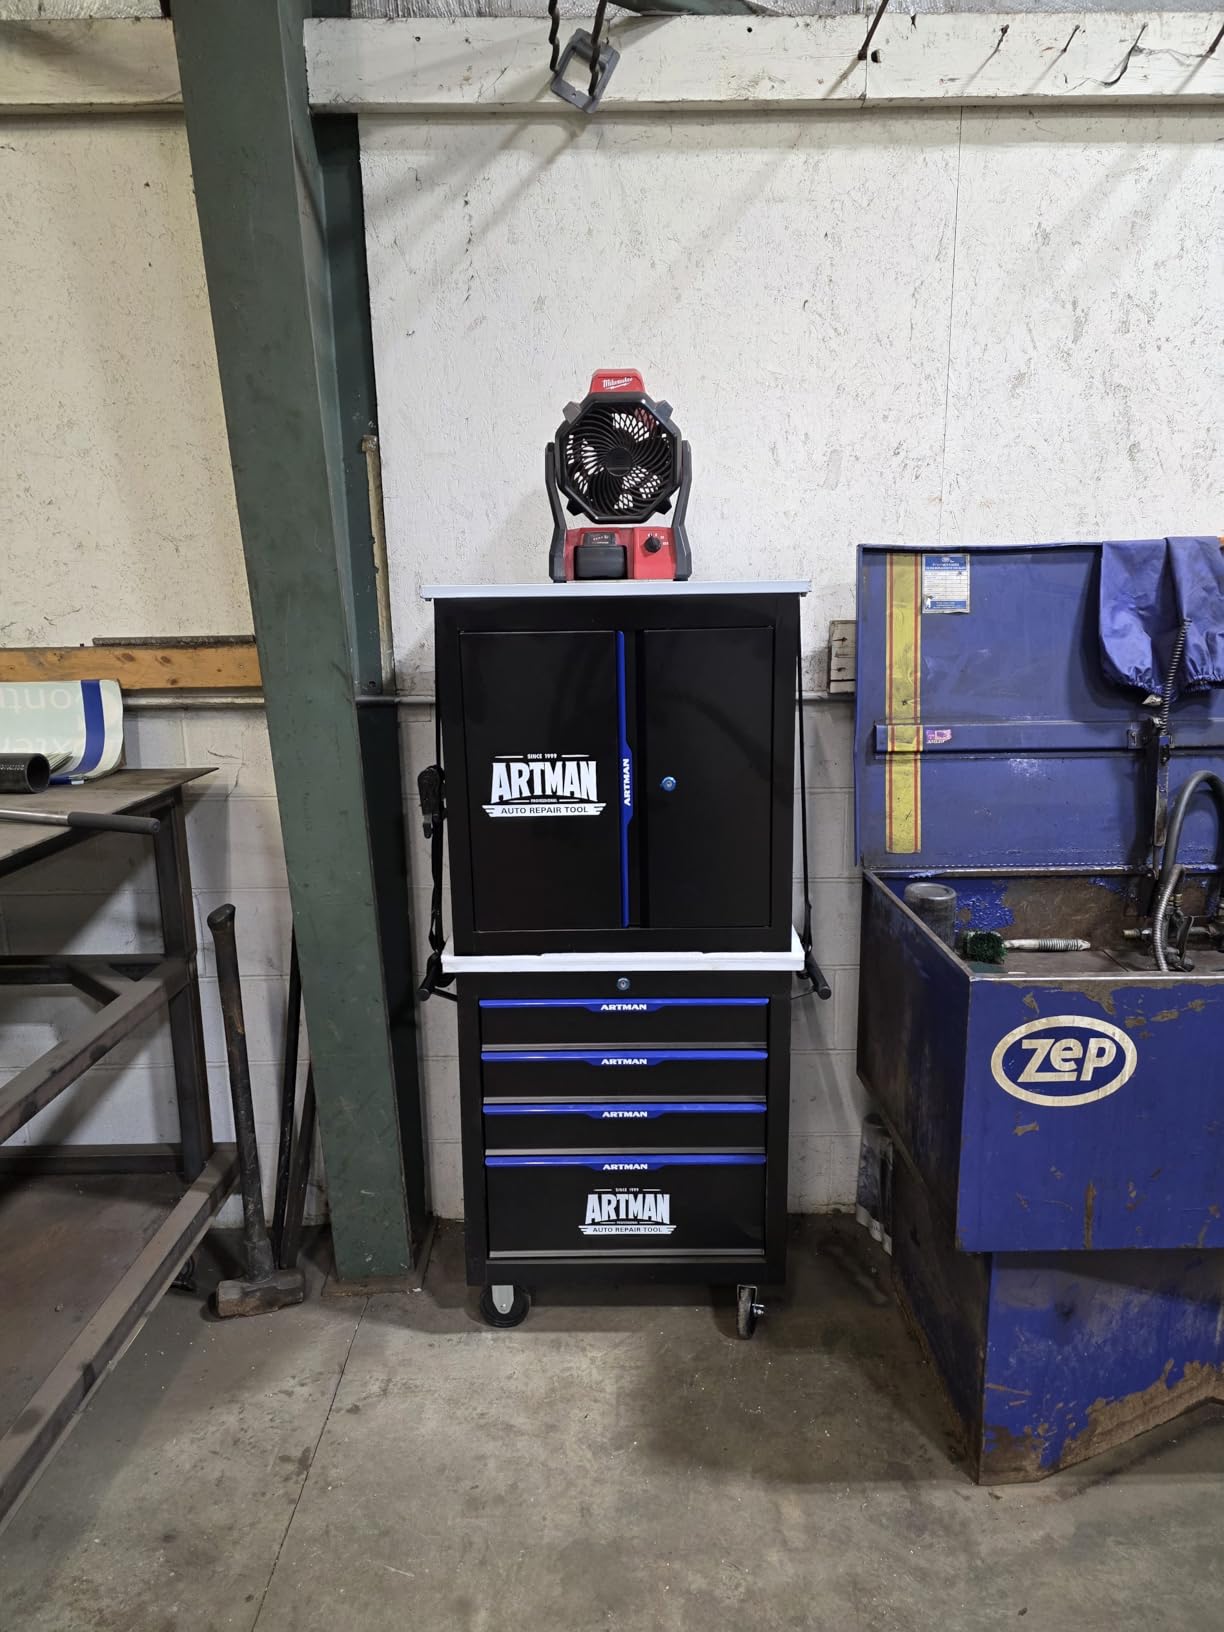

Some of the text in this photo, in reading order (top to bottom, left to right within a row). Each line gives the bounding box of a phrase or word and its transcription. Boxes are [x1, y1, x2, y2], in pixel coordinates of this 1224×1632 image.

[490, 760, 599, 804] ARTMAN
[622, 758, 632, 807] ARTMAN
[501, 805, 588, 815] AUTO REPAIR TOOL
[600, 1003, 647, 1011] ARTMAN
[601, 1057, 648, 1065] ARTMAN
[602, 1163, 649, 1171] ARTMAN
[585, 1193, 670, 1225] ARTMAN
